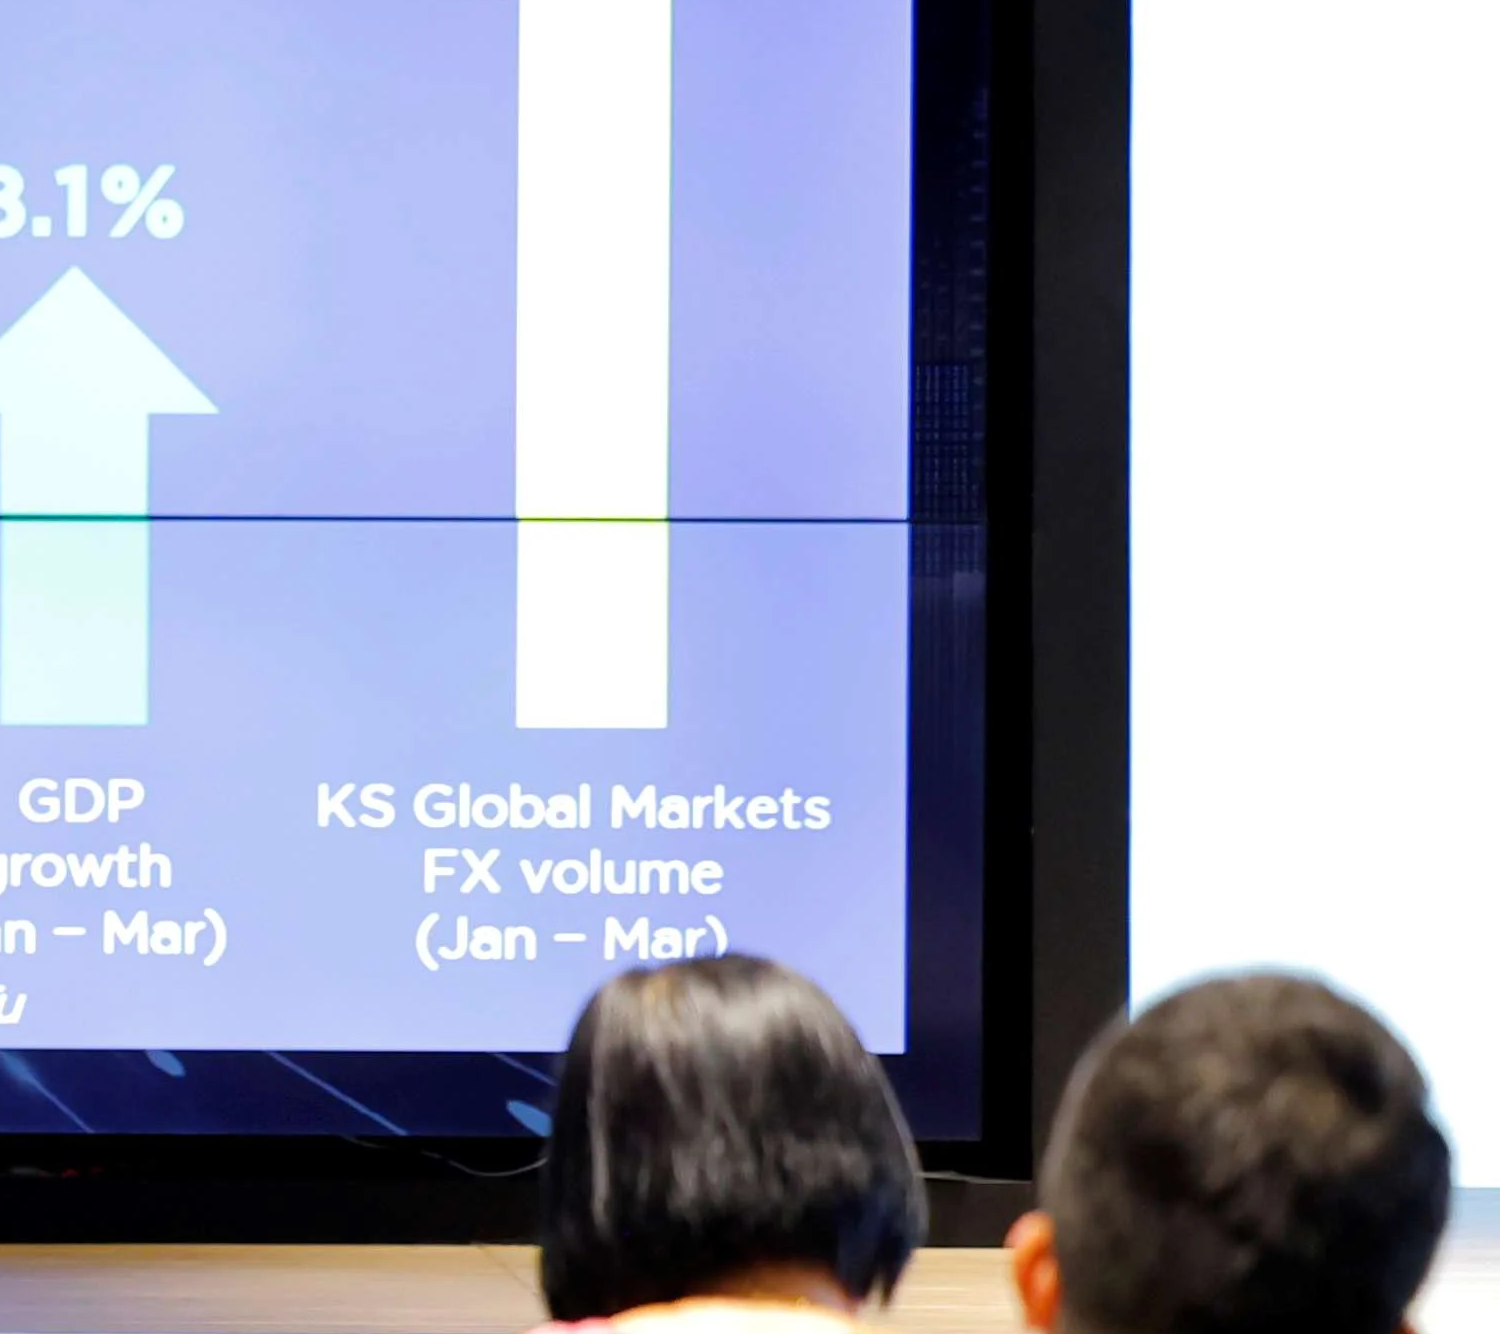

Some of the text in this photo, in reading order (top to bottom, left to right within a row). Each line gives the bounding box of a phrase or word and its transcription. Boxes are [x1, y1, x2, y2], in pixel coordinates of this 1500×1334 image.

[17, 777, 146, 824] GDP
[316, 782, 831, 830] KS Global Markets
[423, 847, 724, 896] FX volume
[102, 907, 228, 967] Mar)
[414, 912, 538, 972] (Jan
[603, 914, 729, 961] Mar)
